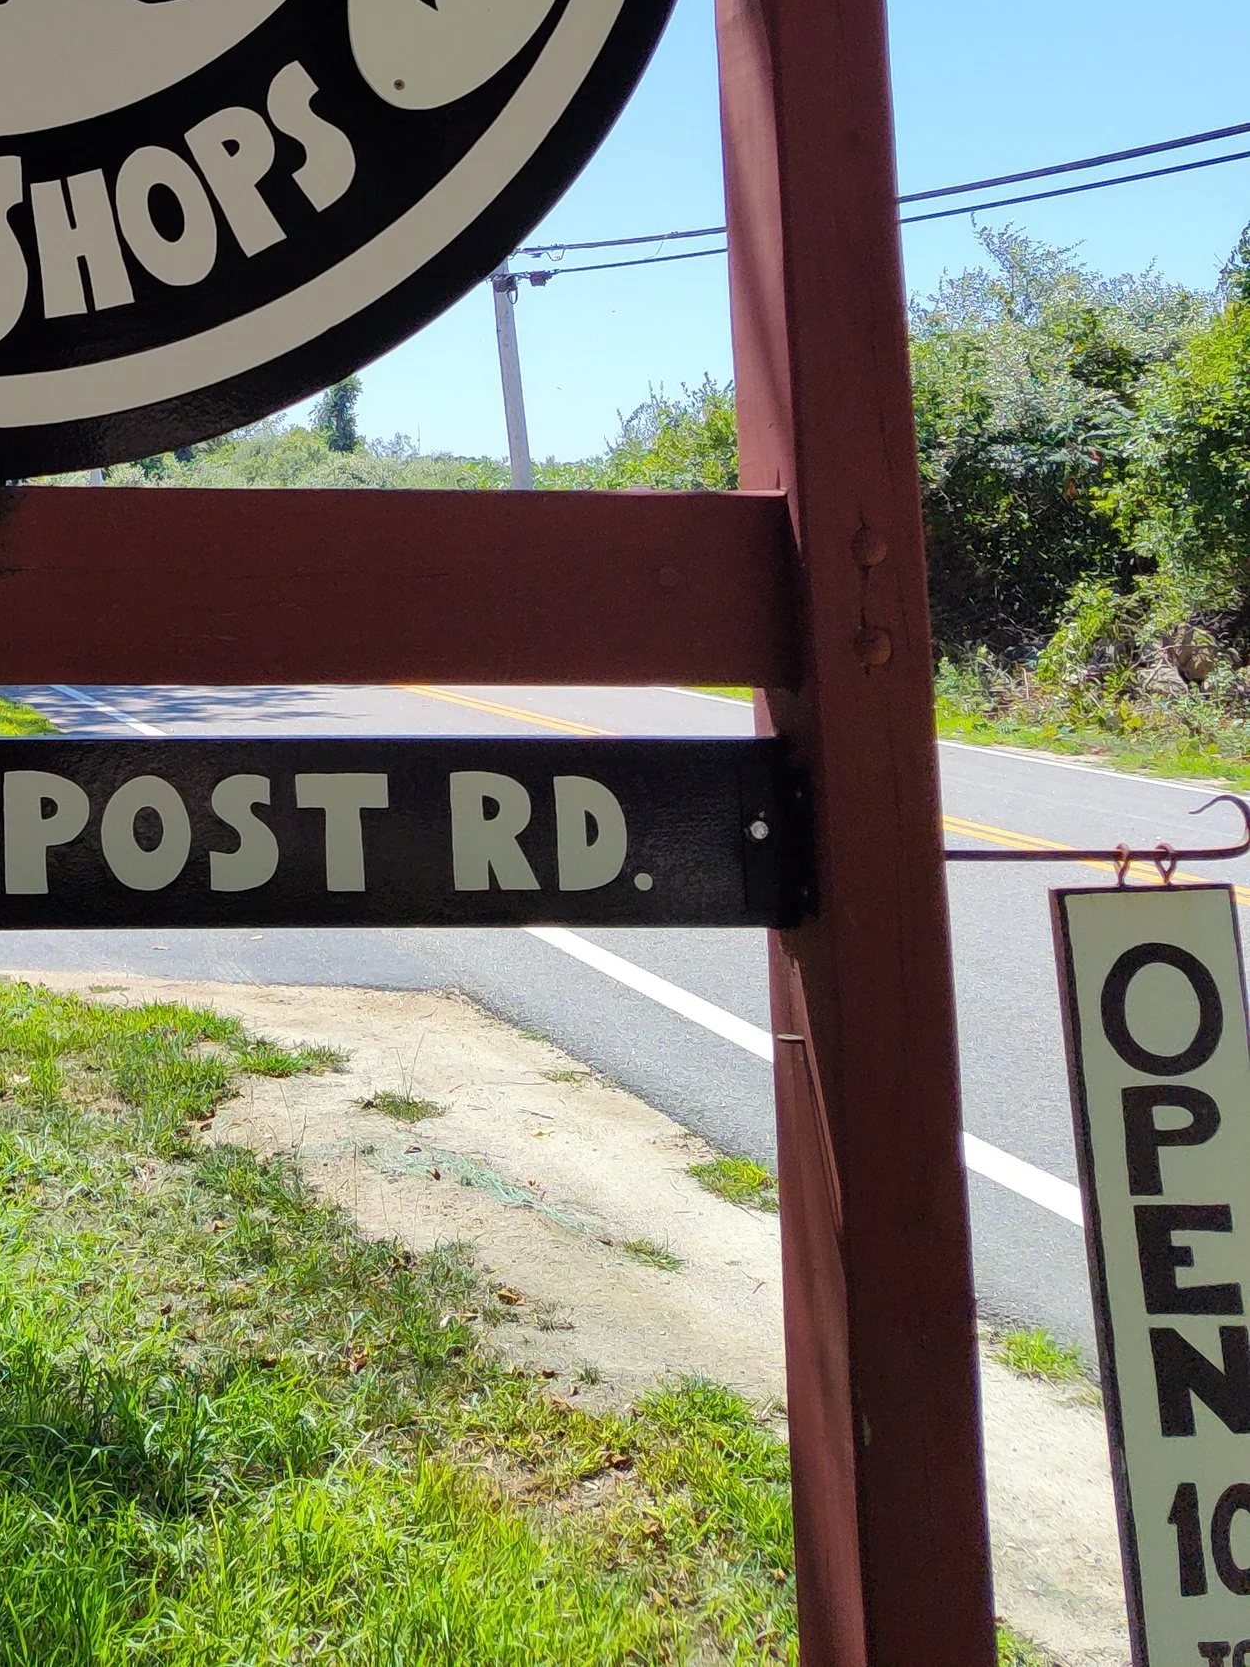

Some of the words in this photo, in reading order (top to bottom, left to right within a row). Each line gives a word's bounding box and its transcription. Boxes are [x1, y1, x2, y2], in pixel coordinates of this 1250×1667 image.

[3, 771, 389, 894] POST
[450, 771, 654, 892] RD.
[1101, 942, 1250, 1437] OPEN
